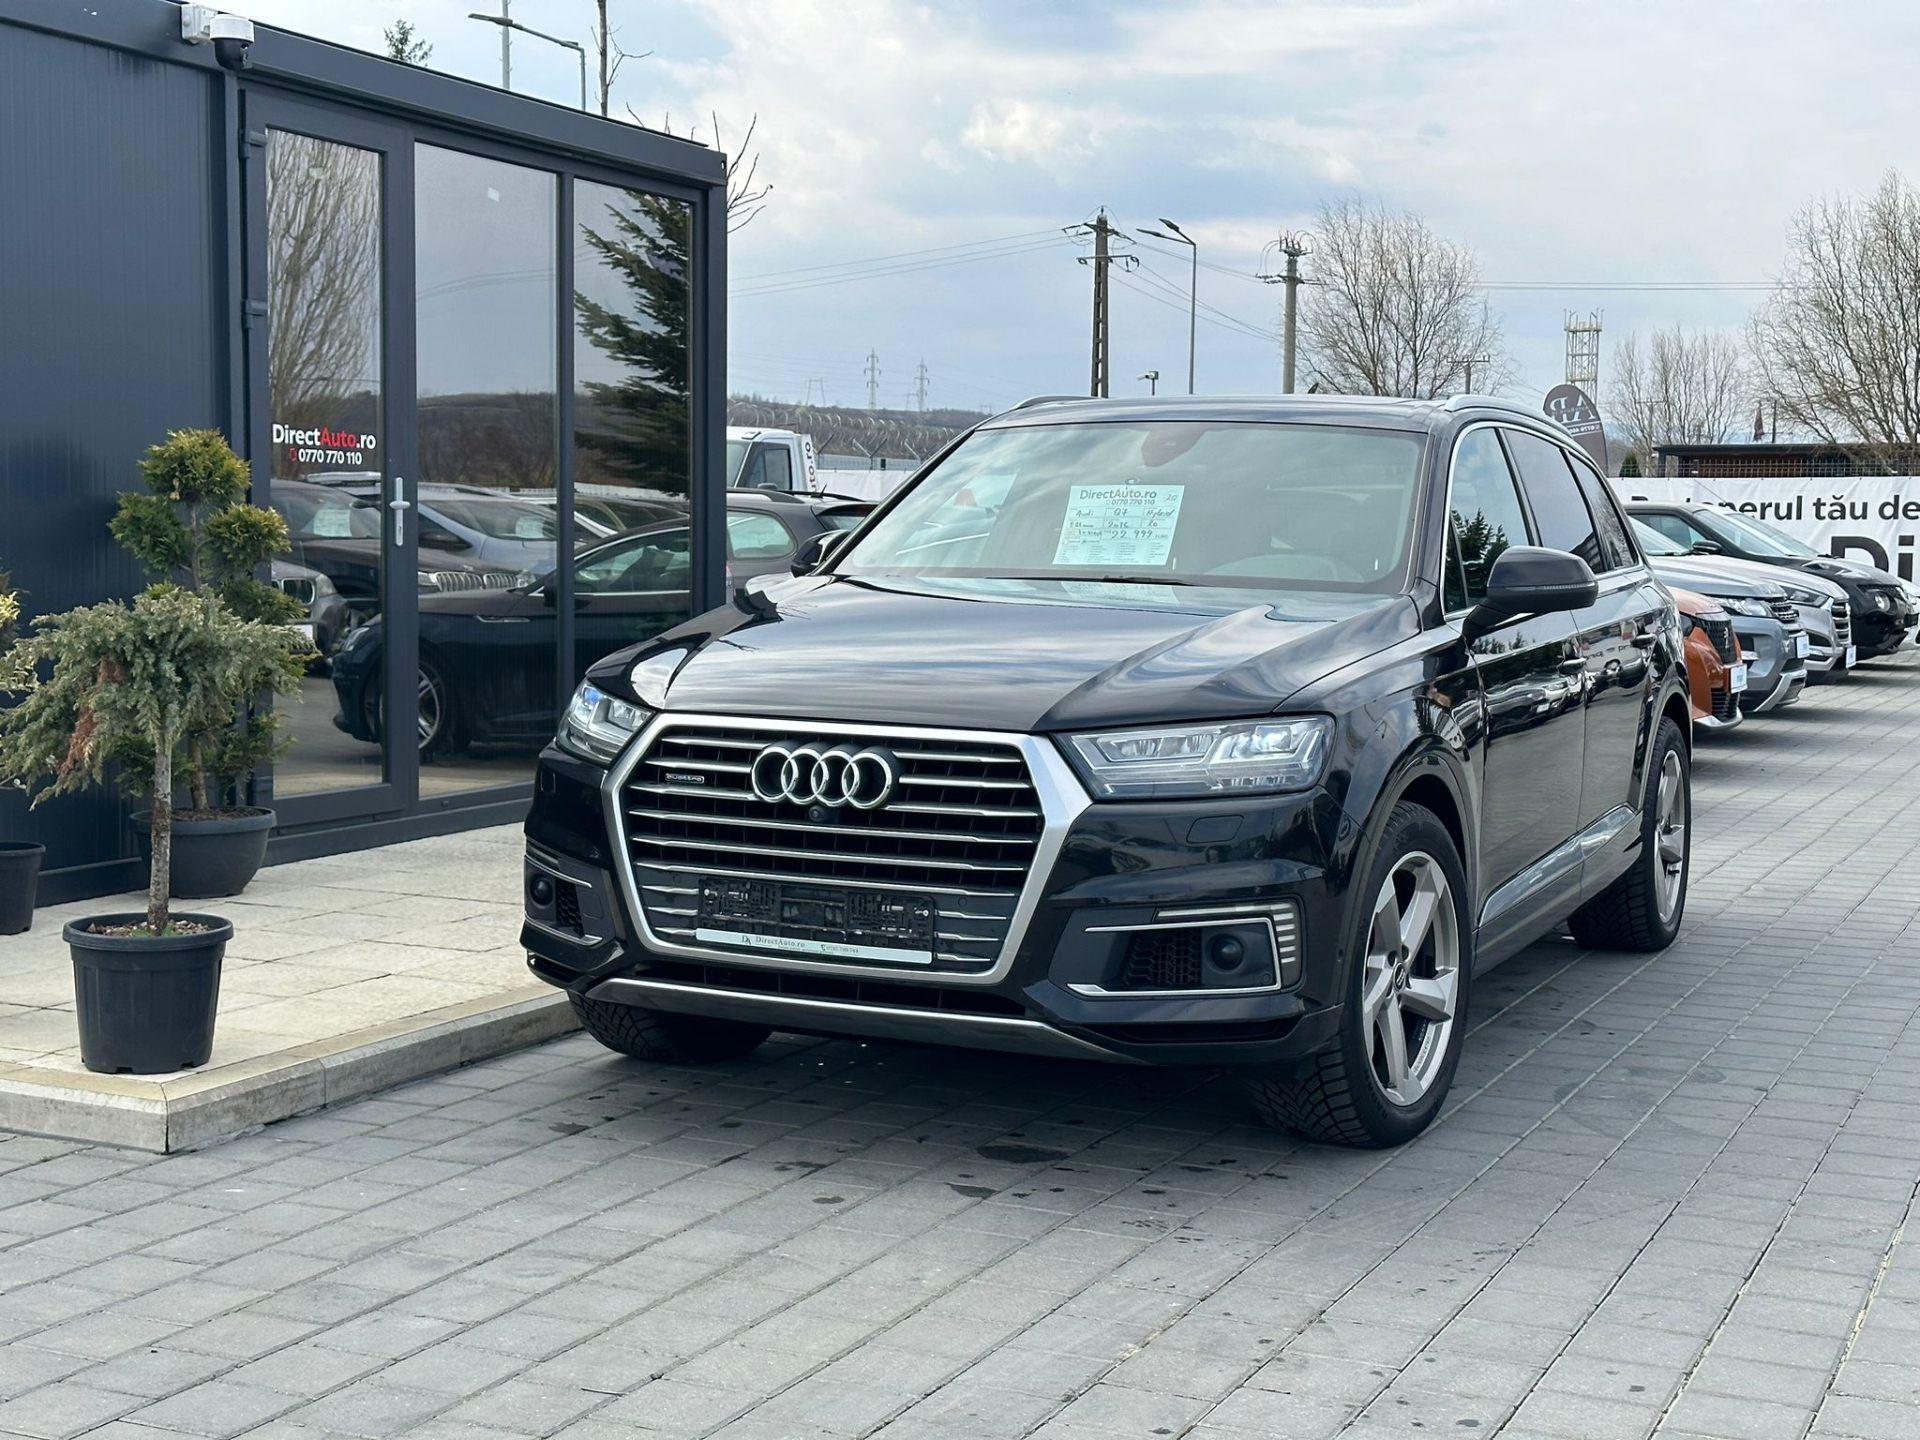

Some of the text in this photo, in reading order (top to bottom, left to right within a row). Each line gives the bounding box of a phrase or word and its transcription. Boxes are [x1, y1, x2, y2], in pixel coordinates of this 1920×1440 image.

[272, 424, 377, 449] DirectAuto.ro
[298, 448, 363, 465] 0770 770 110
[1080, 489, 1157, 500] DirectAuto.ro
[1812, 494, 1868, 520] tău
[1878, 494, 1920, 520] de
